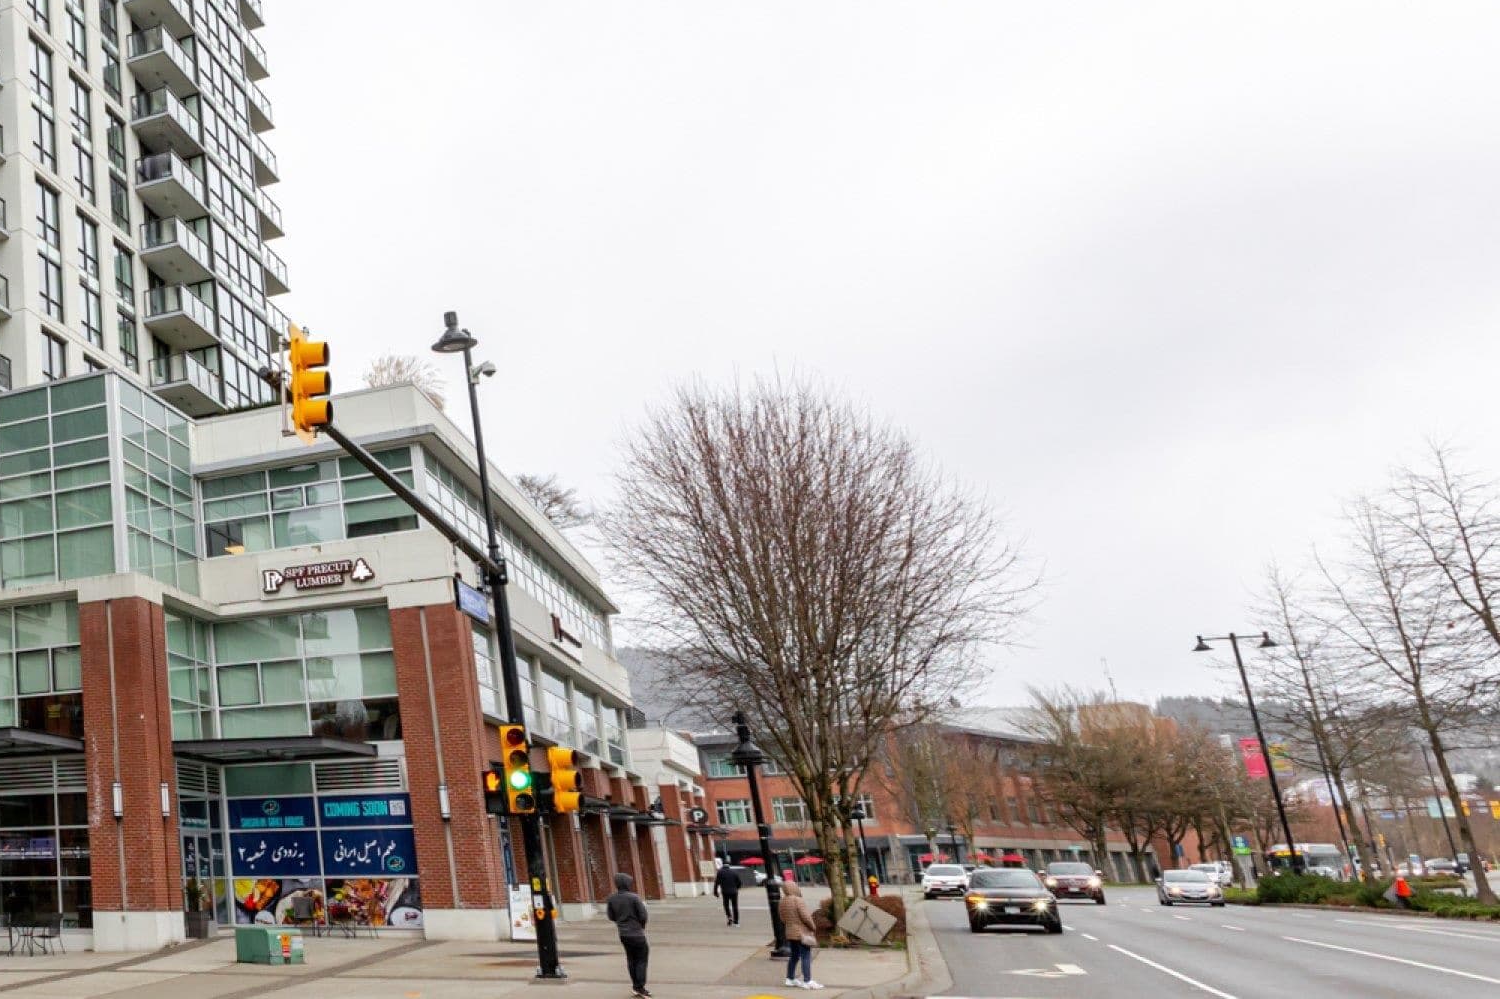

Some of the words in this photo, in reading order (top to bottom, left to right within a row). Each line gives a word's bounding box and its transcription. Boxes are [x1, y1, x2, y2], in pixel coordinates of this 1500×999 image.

[285, 567, 306, 579] SPF
[307, 562, 351, 576] PRECUT
[296, 575, 342, 588] LUMBER
[324, 802, 360, 817] COMING
[362, 801, 388, 816] SOON
[693, 810, 704, 822] P
